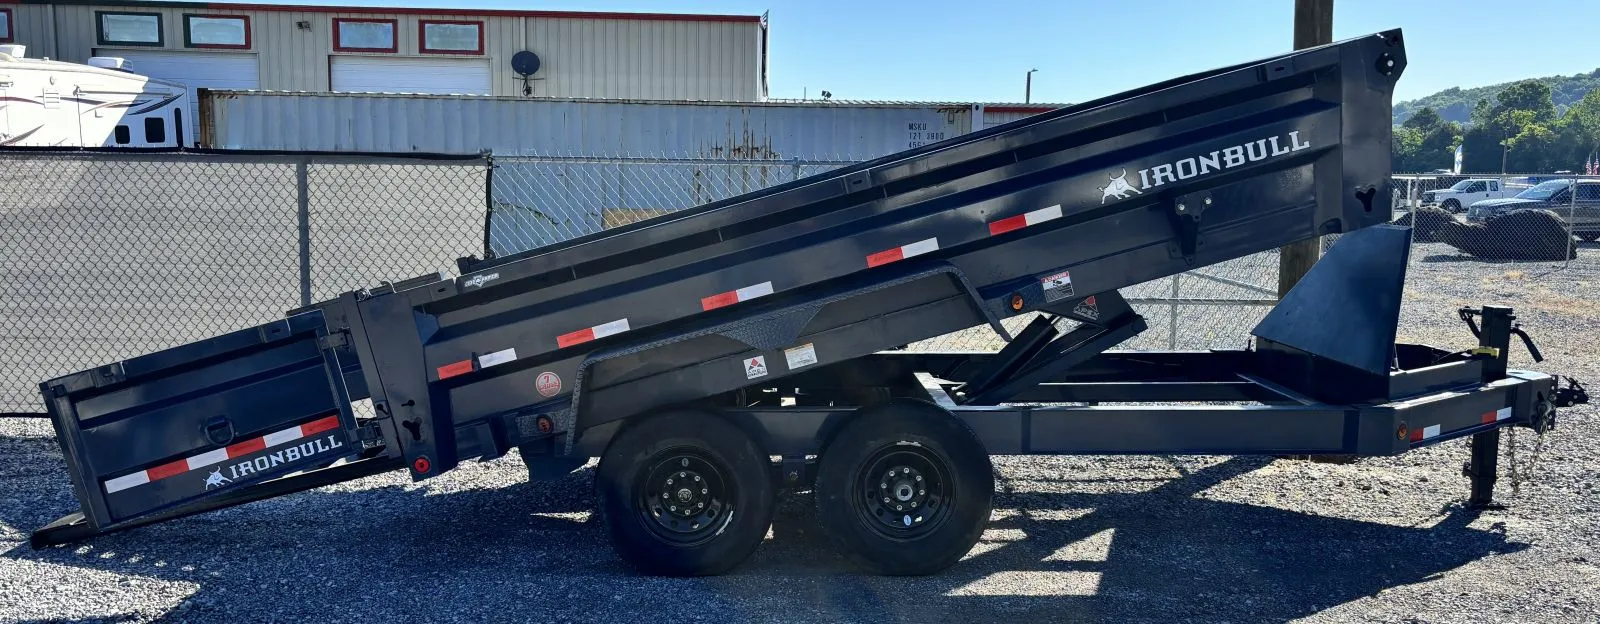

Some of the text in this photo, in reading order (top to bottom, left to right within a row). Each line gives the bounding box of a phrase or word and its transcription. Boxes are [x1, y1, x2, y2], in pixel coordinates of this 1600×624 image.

[909, 122, 927, 131] MSKU
[1138, 130, 1310, 190] IRONBULL
[229, 435, 342, 479] IRONBULL
